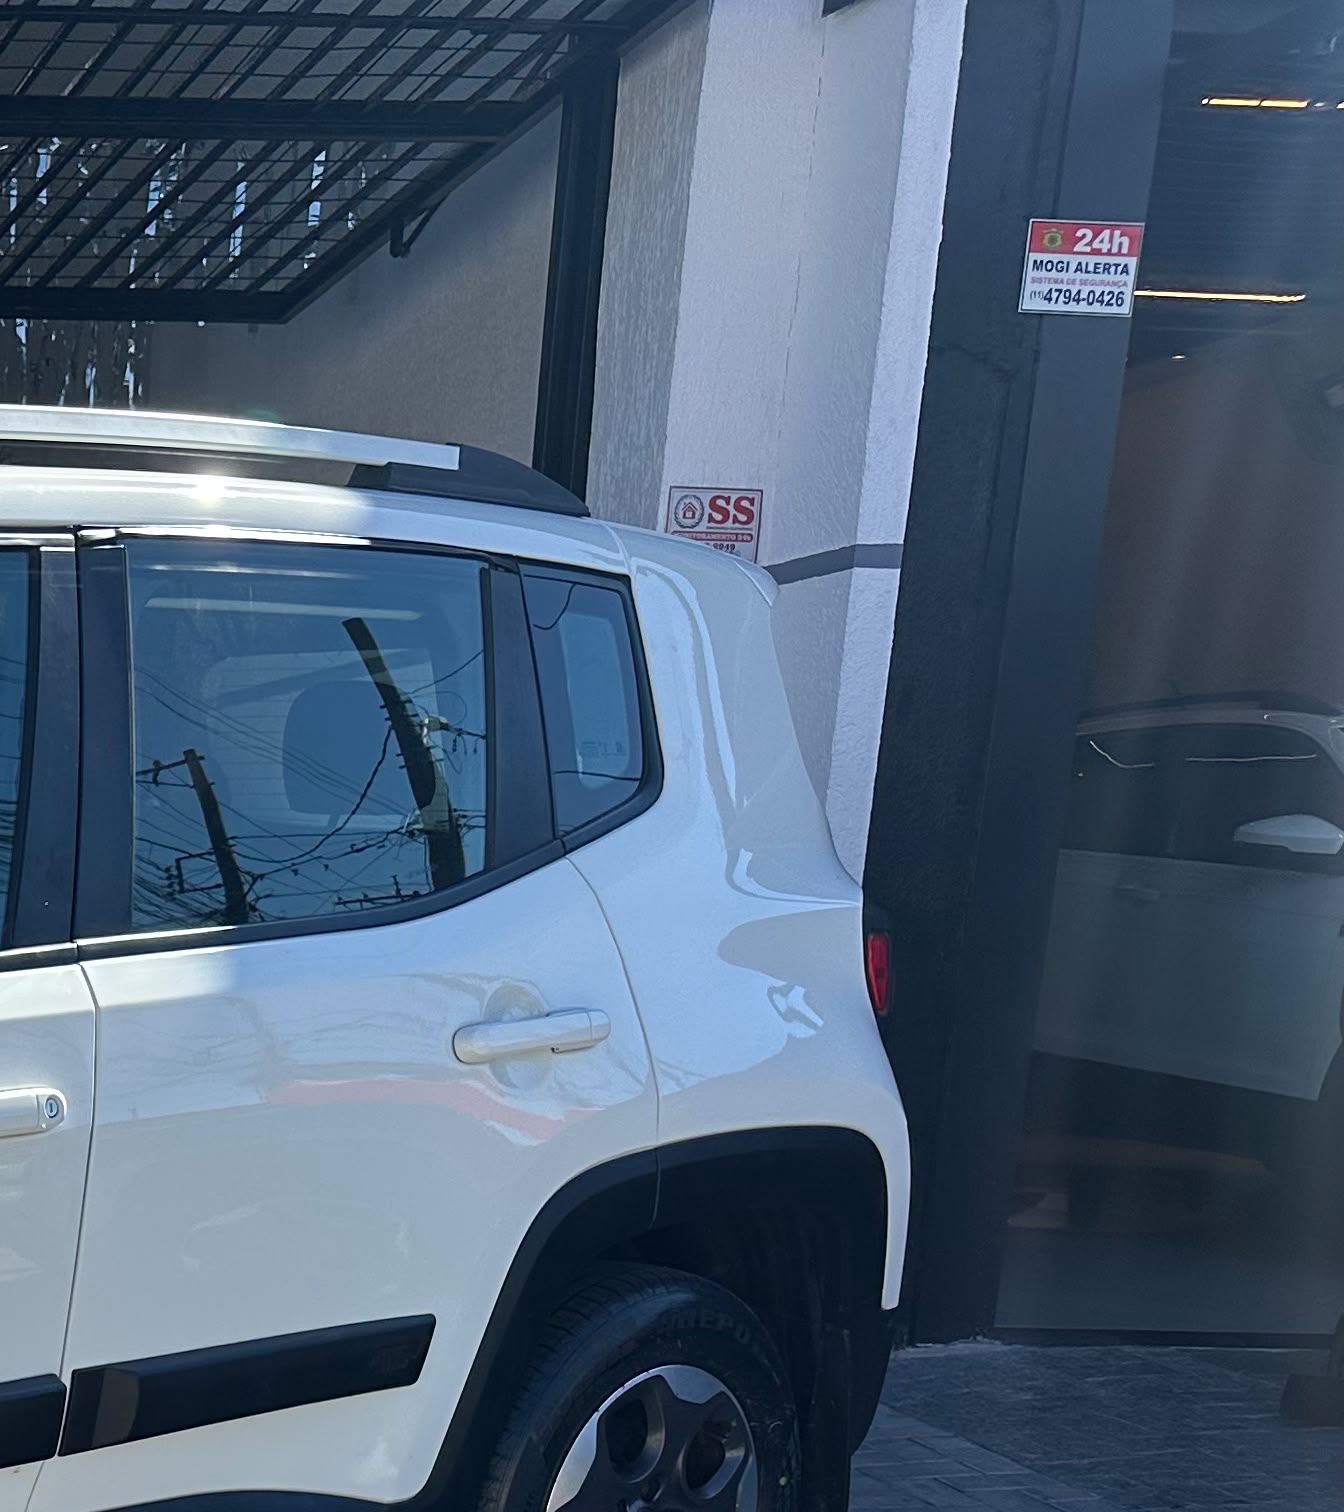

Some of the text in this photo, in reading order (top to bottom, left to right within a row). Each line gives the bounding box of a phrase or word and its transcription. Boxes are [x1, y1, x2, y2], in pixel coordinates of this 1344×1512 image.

[1073, 228, 1130, 254] 24h
[1032, 259, 1130, 276] MOGI ALERTA
[708, 494, 755, 526] SS
